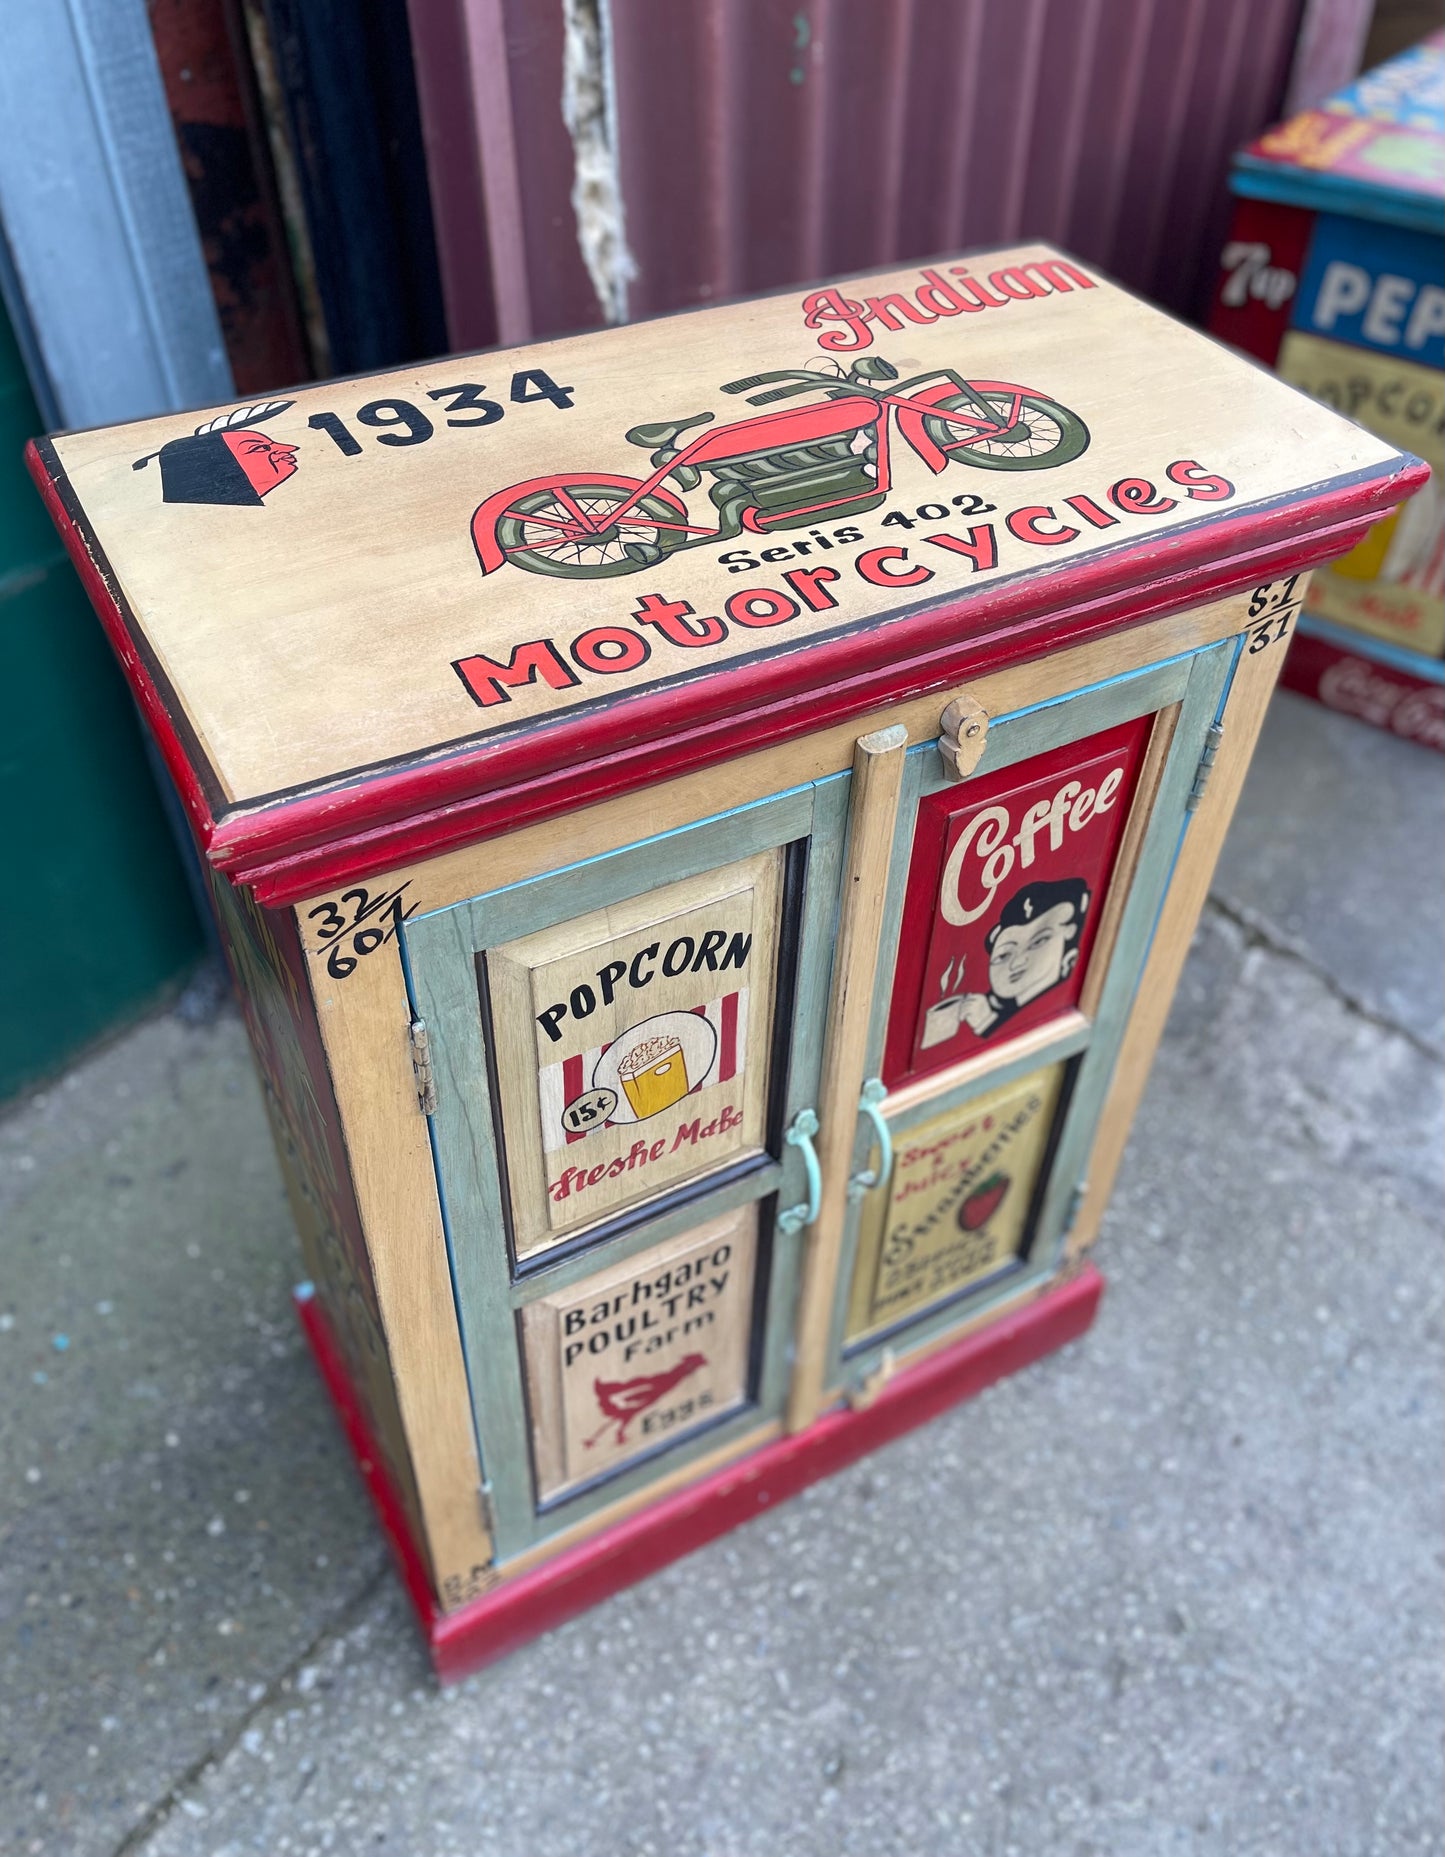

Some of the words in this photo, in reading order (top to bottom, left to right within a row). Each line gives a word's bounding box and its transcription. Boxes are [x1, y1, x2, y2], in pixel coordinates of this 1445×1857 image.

[801, 259, 1100, 352] Indian
[307, 368, 576, 457] 1934
[717, 526, 866, 574] Seris
[879, 493, 998, 531] 402
[1248, 609, 1294, 655] 31
[940, 767, 1125, 927] Coffee
[536, 930, 752, 1043] POPCORN
[565, 1270, 730, 1367] POULTRY
[624, 1311, 715, 1363] Farm
